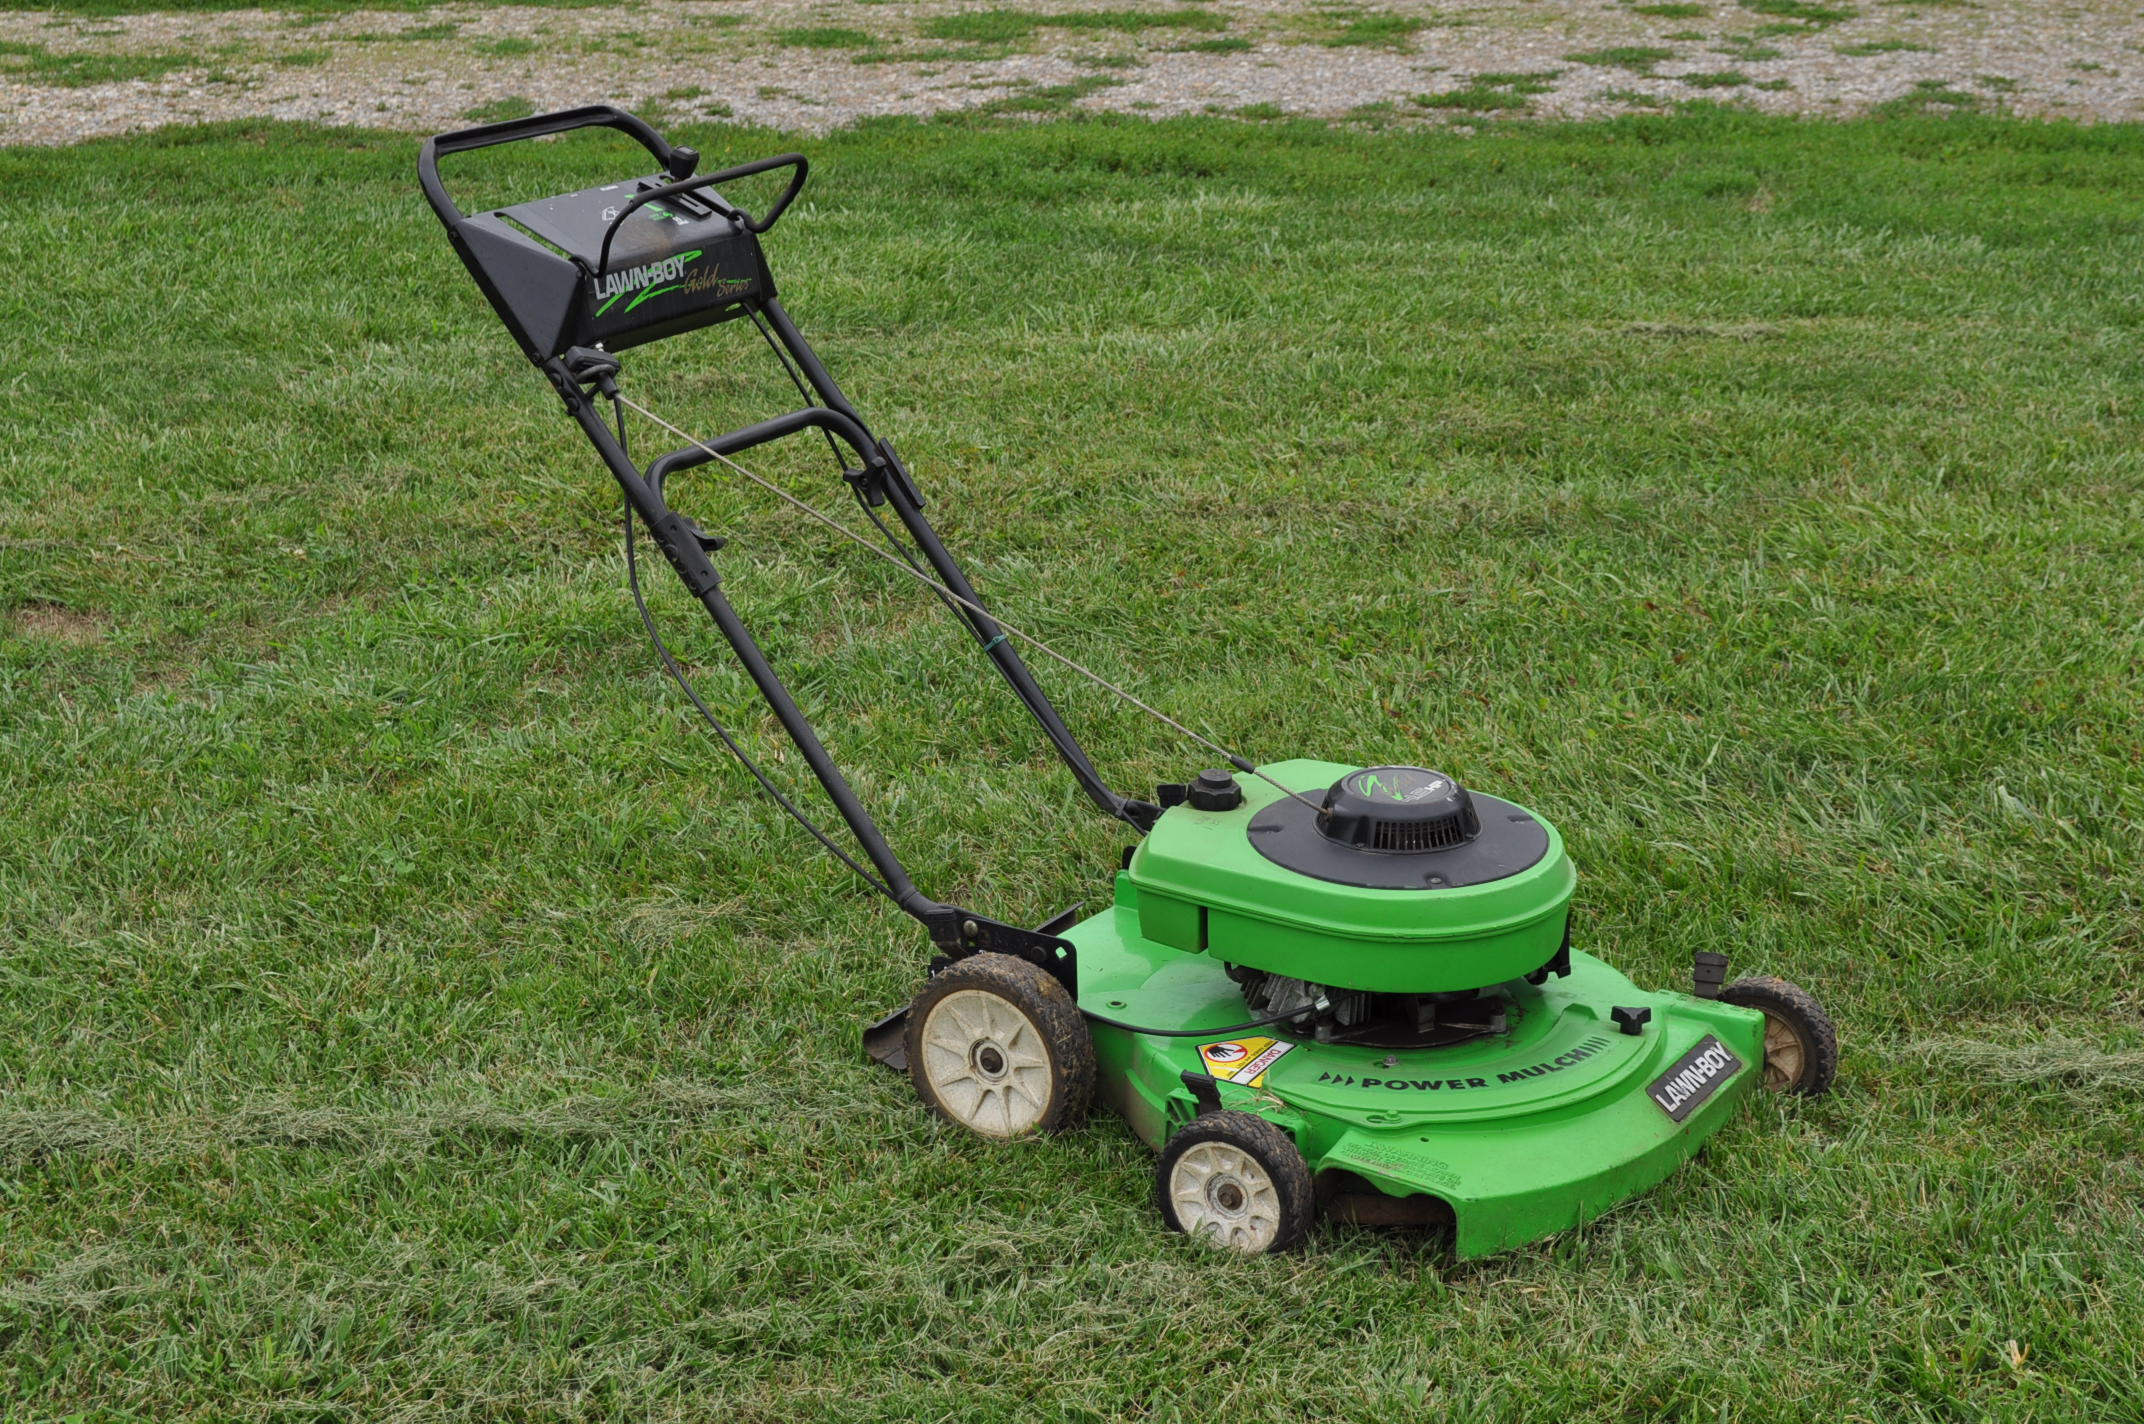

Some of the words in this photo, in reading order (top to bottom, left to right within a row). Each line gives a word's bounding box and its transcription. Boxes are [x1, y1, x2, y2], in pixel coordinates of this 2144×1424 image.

[594, 256, 686, 300] LAWN-BOY
[683, 264, 720, 295] Gold
[1247, 1049, 1282, 1075] DANGER
[1361, 1078, 1490, 1091] POWER
[1496, 1043, 1590, 1084] MULCH
[1655, 1041, 1732, 1112] LAWN-BOY
